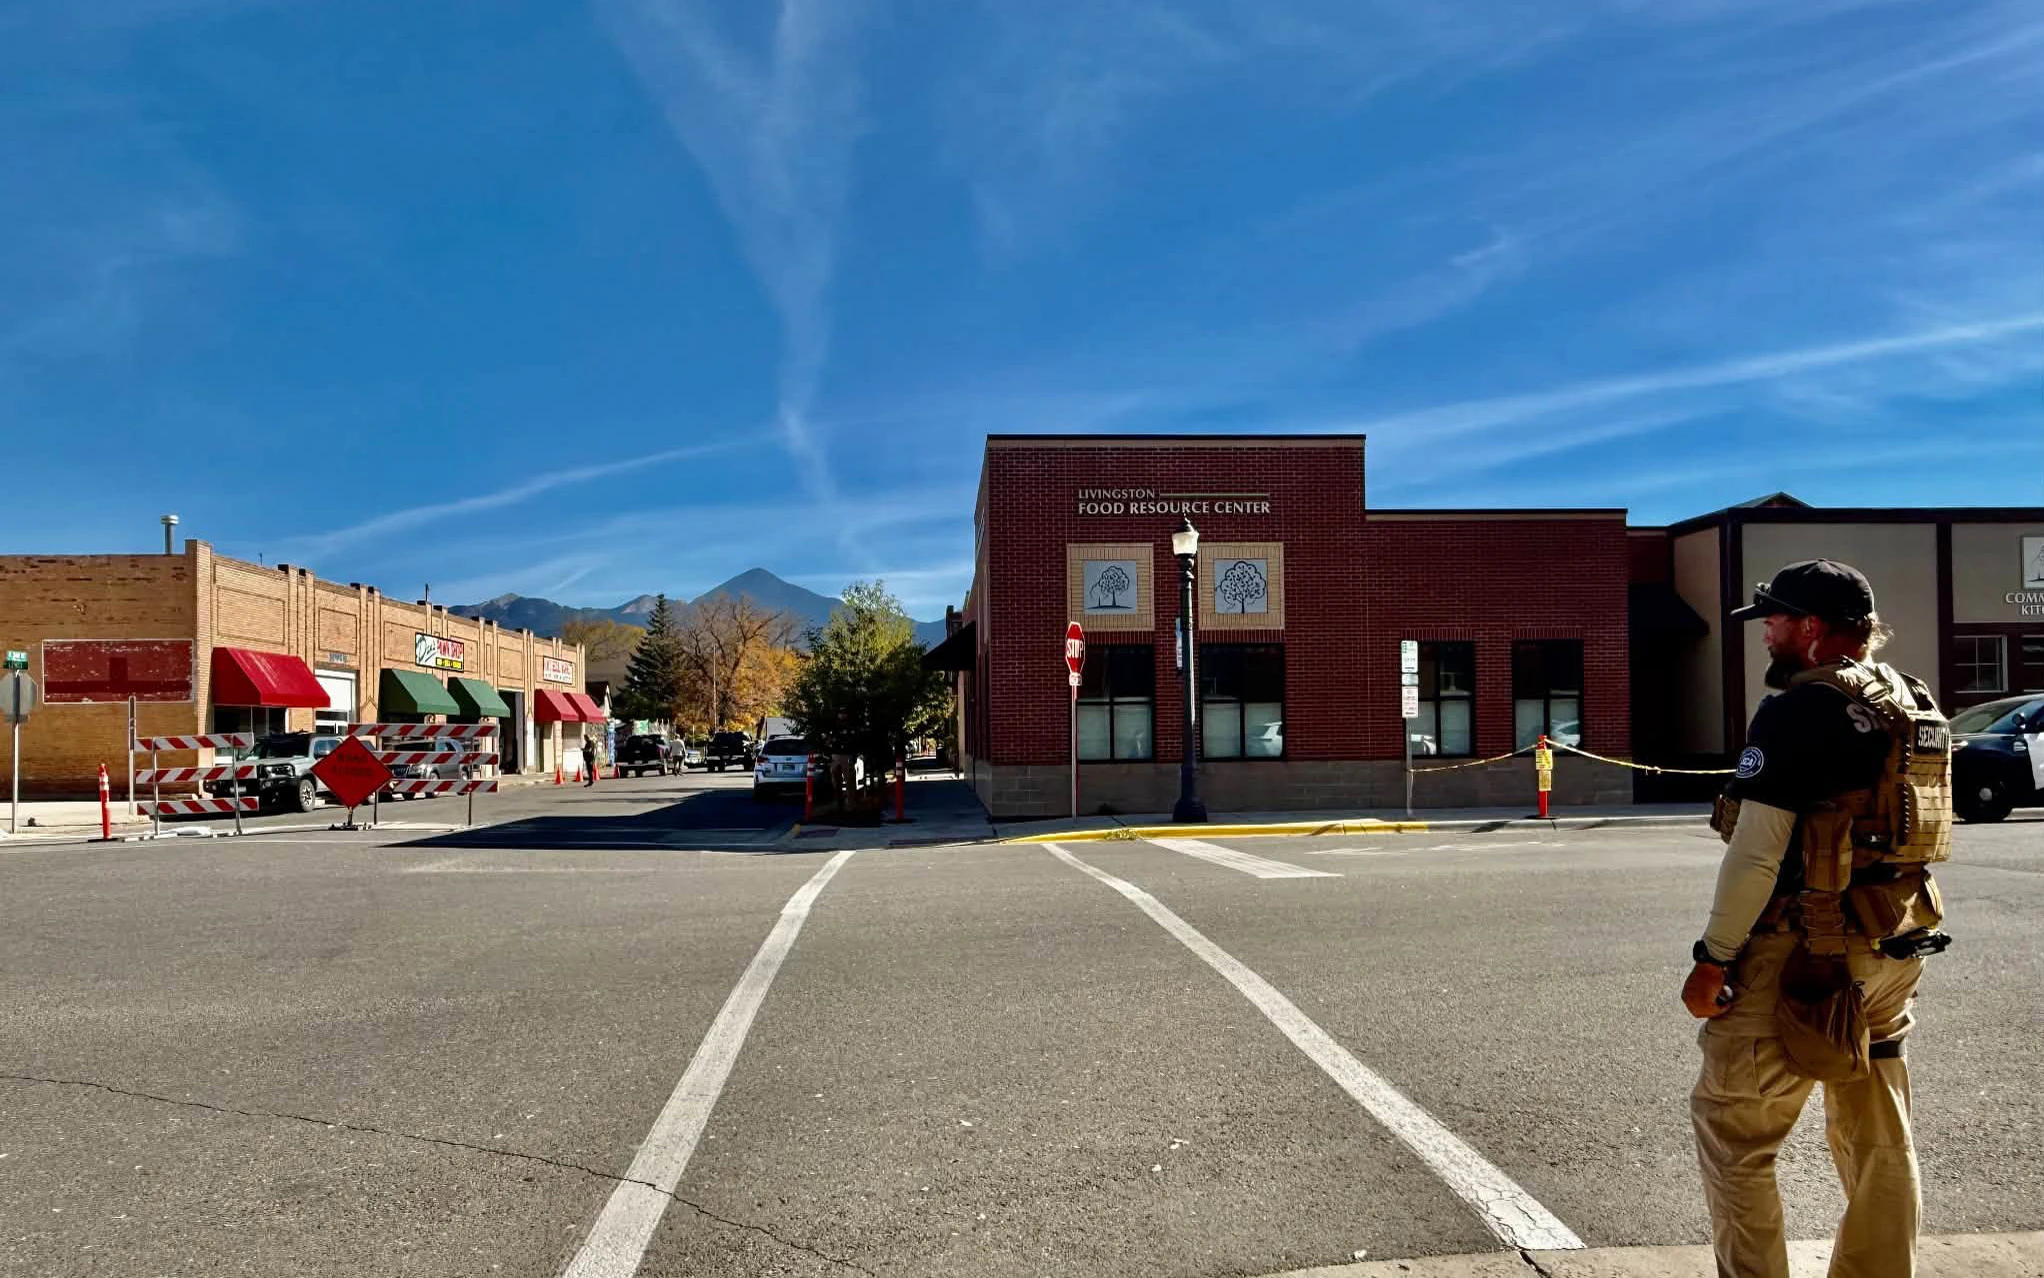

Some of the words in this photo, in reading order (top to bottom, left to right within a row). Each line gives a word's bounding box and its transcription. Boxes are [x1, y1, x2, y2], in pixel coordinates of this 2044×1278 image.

[1079, 488, 1155, 499] LIVINGSTON
[1079, 502, 1124, 514] FOOD
[1130, 501, 1209, 514] RESOURCE
[1214, 501, 1270, 513] CENTER
[2021, 604, 2044, 615] KIT
[1066, 638, 1084, 658] STOP
[1918, 725, 1949, 750] SECURITY
